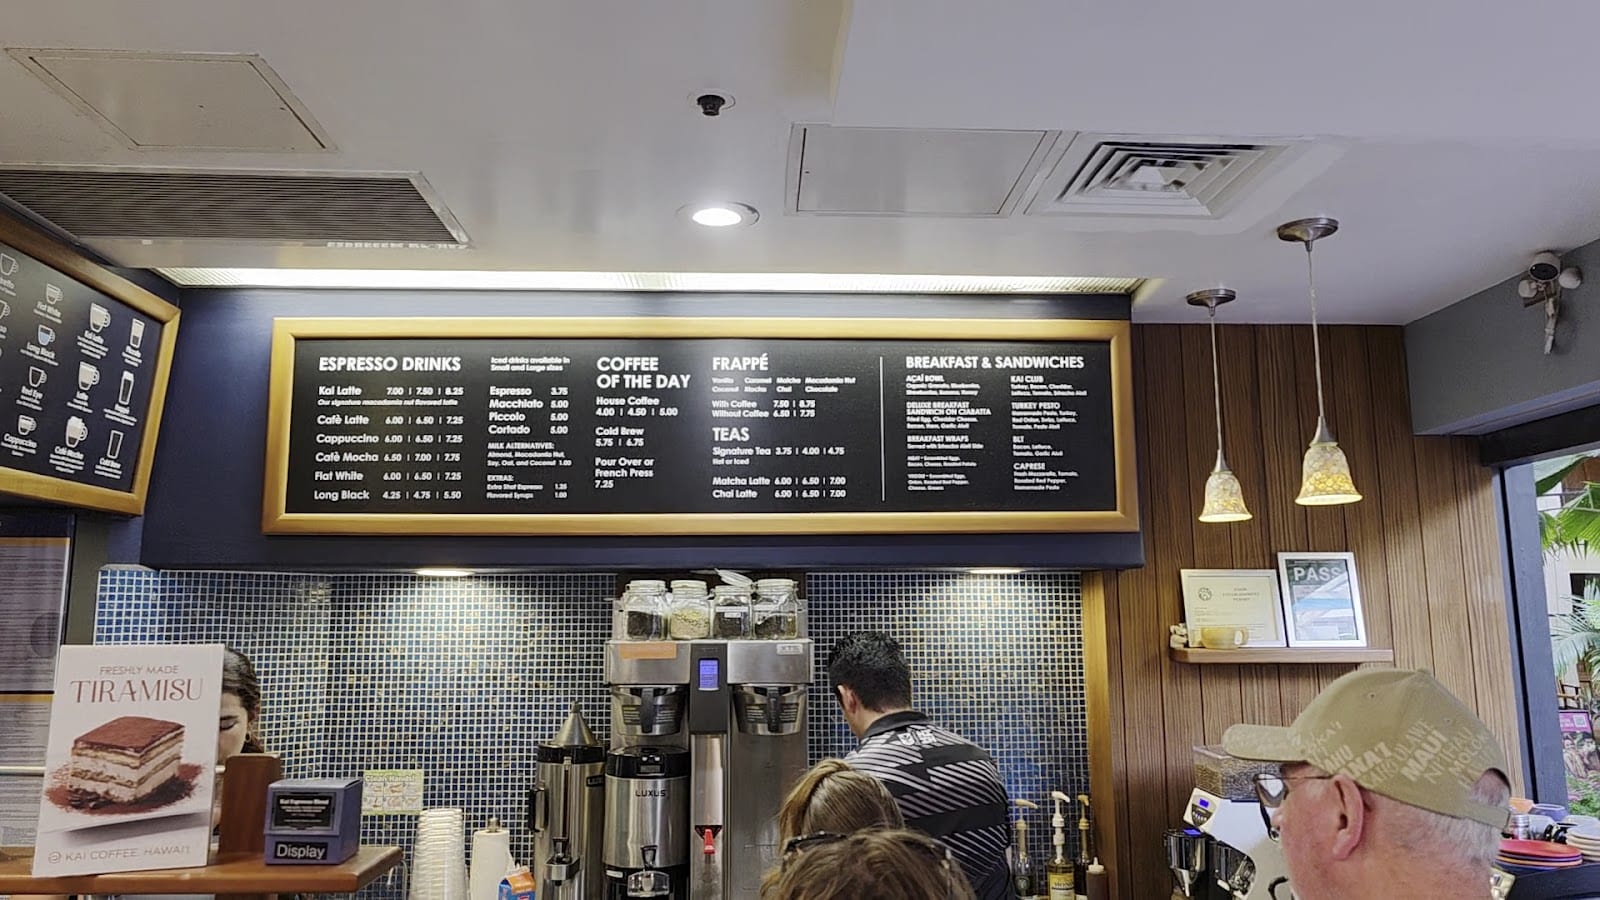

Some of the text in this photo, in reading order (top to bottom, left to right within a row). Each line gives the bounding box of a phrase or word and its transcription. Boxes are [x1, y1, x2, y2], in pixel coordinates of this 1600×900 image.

[319, 357, 461, 371] ESPRESSO DRINKS
[597, 357, 658, 371] COFFEE
[713, 353, 768, 370] FRAPPÉ
[906, 356, 1084, 368] BREAKFAST & SANDWICHES
[597, 374, 690, 388] OF THE DAY
[319, 386, 463, 395] Kai Latte 7.00 7.50 8.25
[490, 386, 568, 397] Espresso 3.75
[489, 399, 568, 408] Macchiato 5.00
[596, 396, 659, 405] House Coffee
[730, 400, 757, 408] Coffee
[773, 400, 789, 408] 7.50
[489, 412, 568, 421] Piccolo 5.00
[596, 408, 678, 416] 4.00 4.50 5.00
[345, 415, 369, 424] Latte
[386, 416, 403, 424] 6.00
[416, 416, 434, 424] 6.50
[447, 416, 463, 424] 7.25
[488, 425, 568, 434] Cortado 5.00
[596, 427, 644, 435] Cold Brew
[712, 427, 749, 441] TEAS
[317, 434, 379, 444] Cappuccino
[415, 435, 433, 443] 6.50
[446, 435, 462, 443] 7.25
[596, 438, 644, 446] 5.75 6.75
[343, 452, 378, 461] Mocha
[415, 453, 431, 461] 7.00
[445, 453, 460, 461] 7.75
[713, 447, 844, 457] Signature Tea 3.75 4.00 4.75
[595, 458, 616, 466] Pour
[618, 457, 642, 466] Over
[315, 471, 461, 480] Flat White 6.00 6.50 7.25
[595, 468, 653, 477] French Press
[595, 480, 613, 488] 7.25
[713, 477, 747, 485] Matcha
[749, 477, 770, 485] Latte
[775, 477, 792, 485] 6.00
[314, 490, 461, 501] Long Black 4.25 4.75 5.50
[713, 490, 734, 498] Chai
[736, 490, 757, 498] Latte
[1293, 567, 1342, 581] PASS
[100, 665, 180, 675] FRESHLY MADE
[70, 678, 203, 703] TIRAMISU
[1400, 730, 1448, 782] MAUI
[635, 789, 667, 797] LUXUS
[65, 852, 86, 861] KAI
[90, 848, 138, 860] COFFEE
[277, 844, 325, 859] Display
